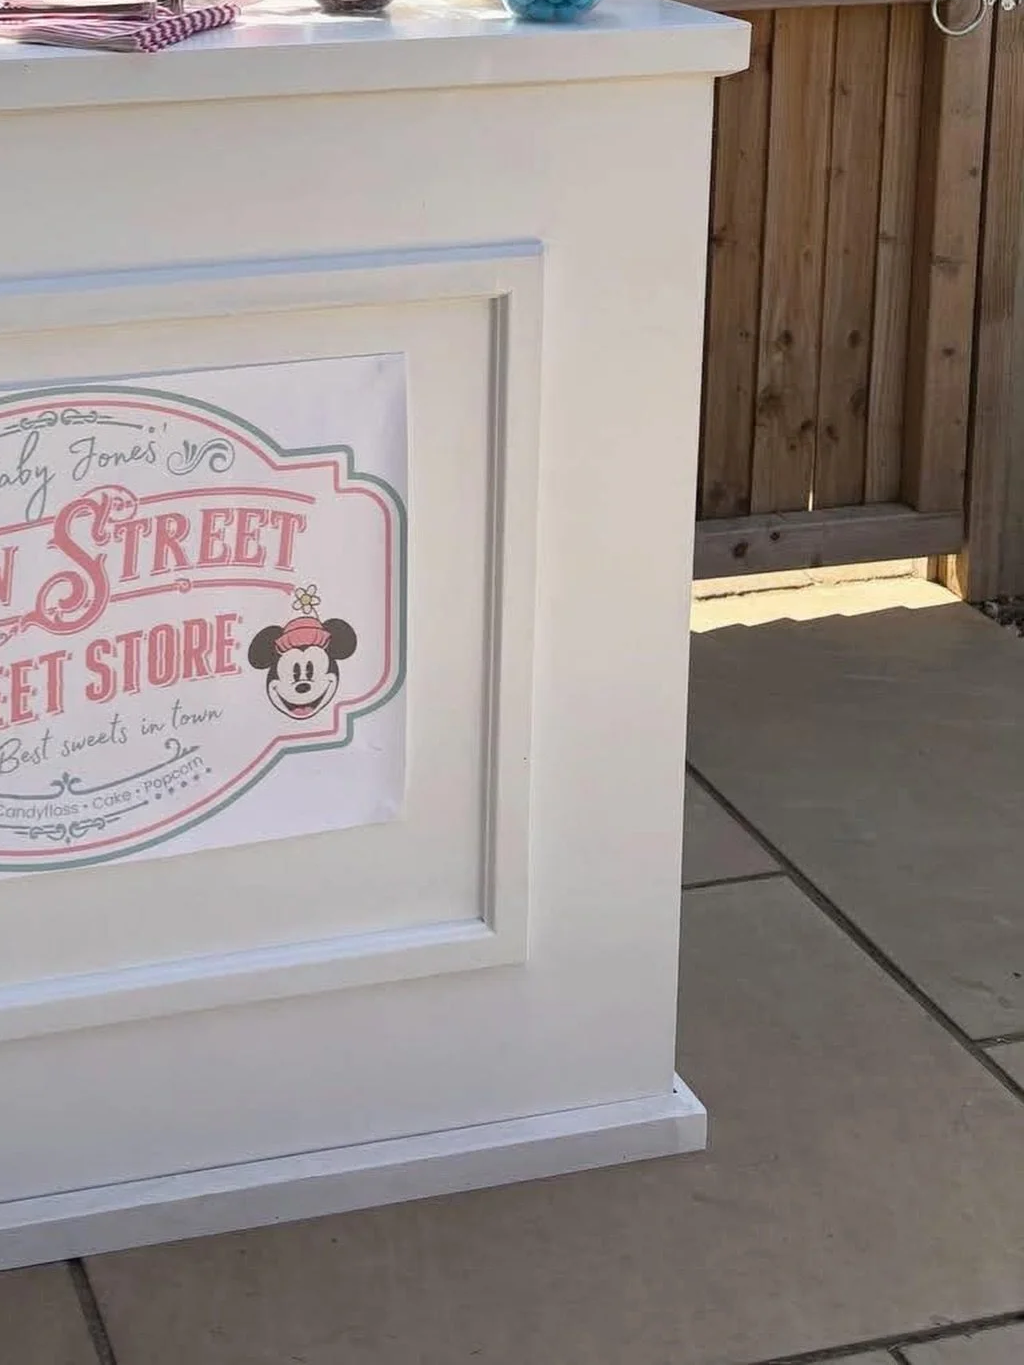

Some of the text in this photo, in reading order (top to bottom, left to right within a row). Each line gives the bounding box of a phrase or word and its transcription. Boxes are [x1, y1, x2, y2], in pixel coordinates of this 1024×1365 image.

[21, 486, 308, 635] STREET
[84, 612, 243, 704] STORE
[61, 713, 128, 757] sweets
[141, 717, 165, 735] in
[171, 699, 223, 730] town
[92, 789, 133, 810] Cake
[143, 755, 204, 793] Popcorn
